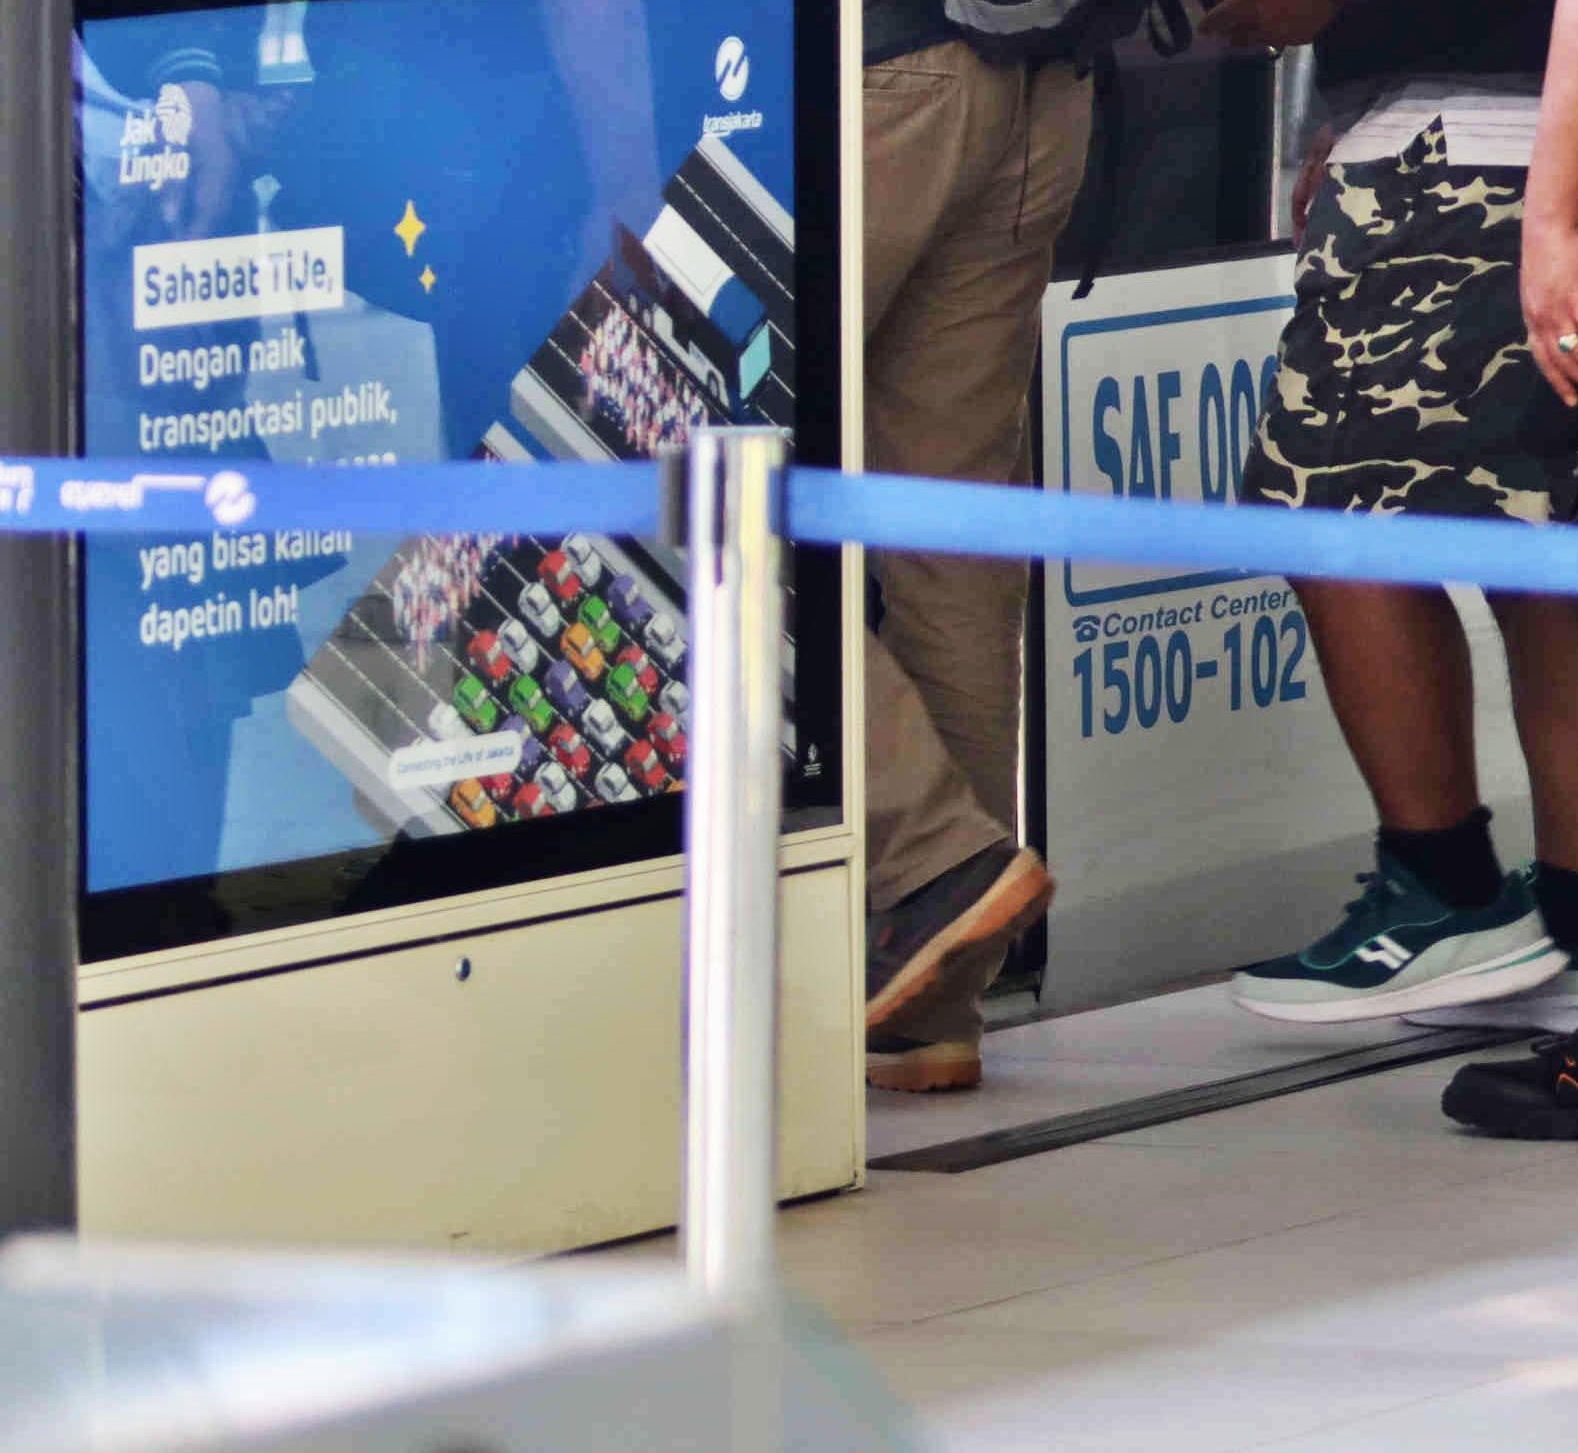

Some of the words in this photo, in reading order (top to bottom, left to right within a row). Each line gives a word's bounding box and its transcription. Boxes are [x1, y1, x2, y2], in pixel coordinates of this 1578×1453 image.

[120, 145, 190, 191] Lingko
[145, 259, 260, 307] Sahabat
[139, 343, 242, 390] Dengan
[249, 327, 306, 372] naik
[139, 389, 303, 452] transportasi
[311, 381, 398, 439] publik,
[1199, 354, 1281, 507] 00
[139, 541, 205, 591] yang
[211, 529, 267, 571] bisa
[139, 591, 242, 651] dapetin
[249, 582, 299, 629] loh!
[1103, 601, 1203, 637] Contact
[1211, 588, 1292, 619] Center
[1073, 610, 1307, 738] 1500-102
